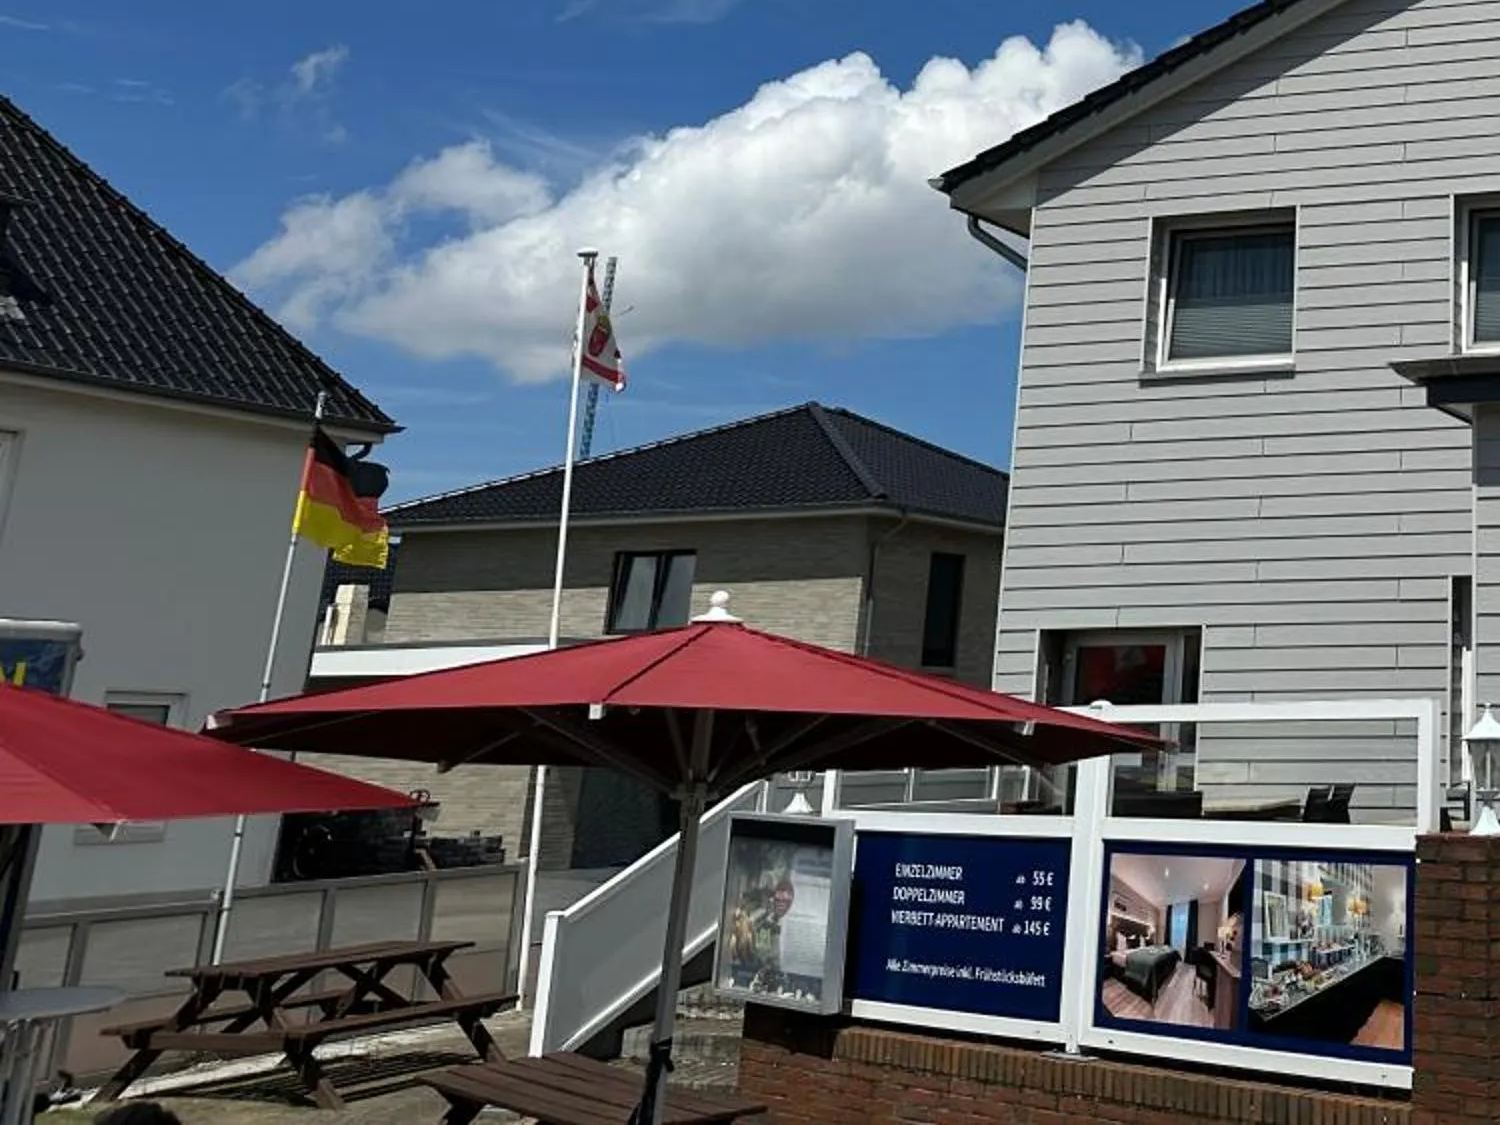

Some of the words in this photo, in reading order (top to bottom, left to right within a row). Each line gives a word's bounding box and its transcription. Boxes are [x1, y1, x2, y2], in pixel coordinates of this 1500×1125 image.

[895, 862, 963, 880] EINZELZIMMER
[1032, 870, 1046, 886] 55
[893, 886, 965, 906] DOPPELZIMMER
[1023, 919, 1043, 936] 145
